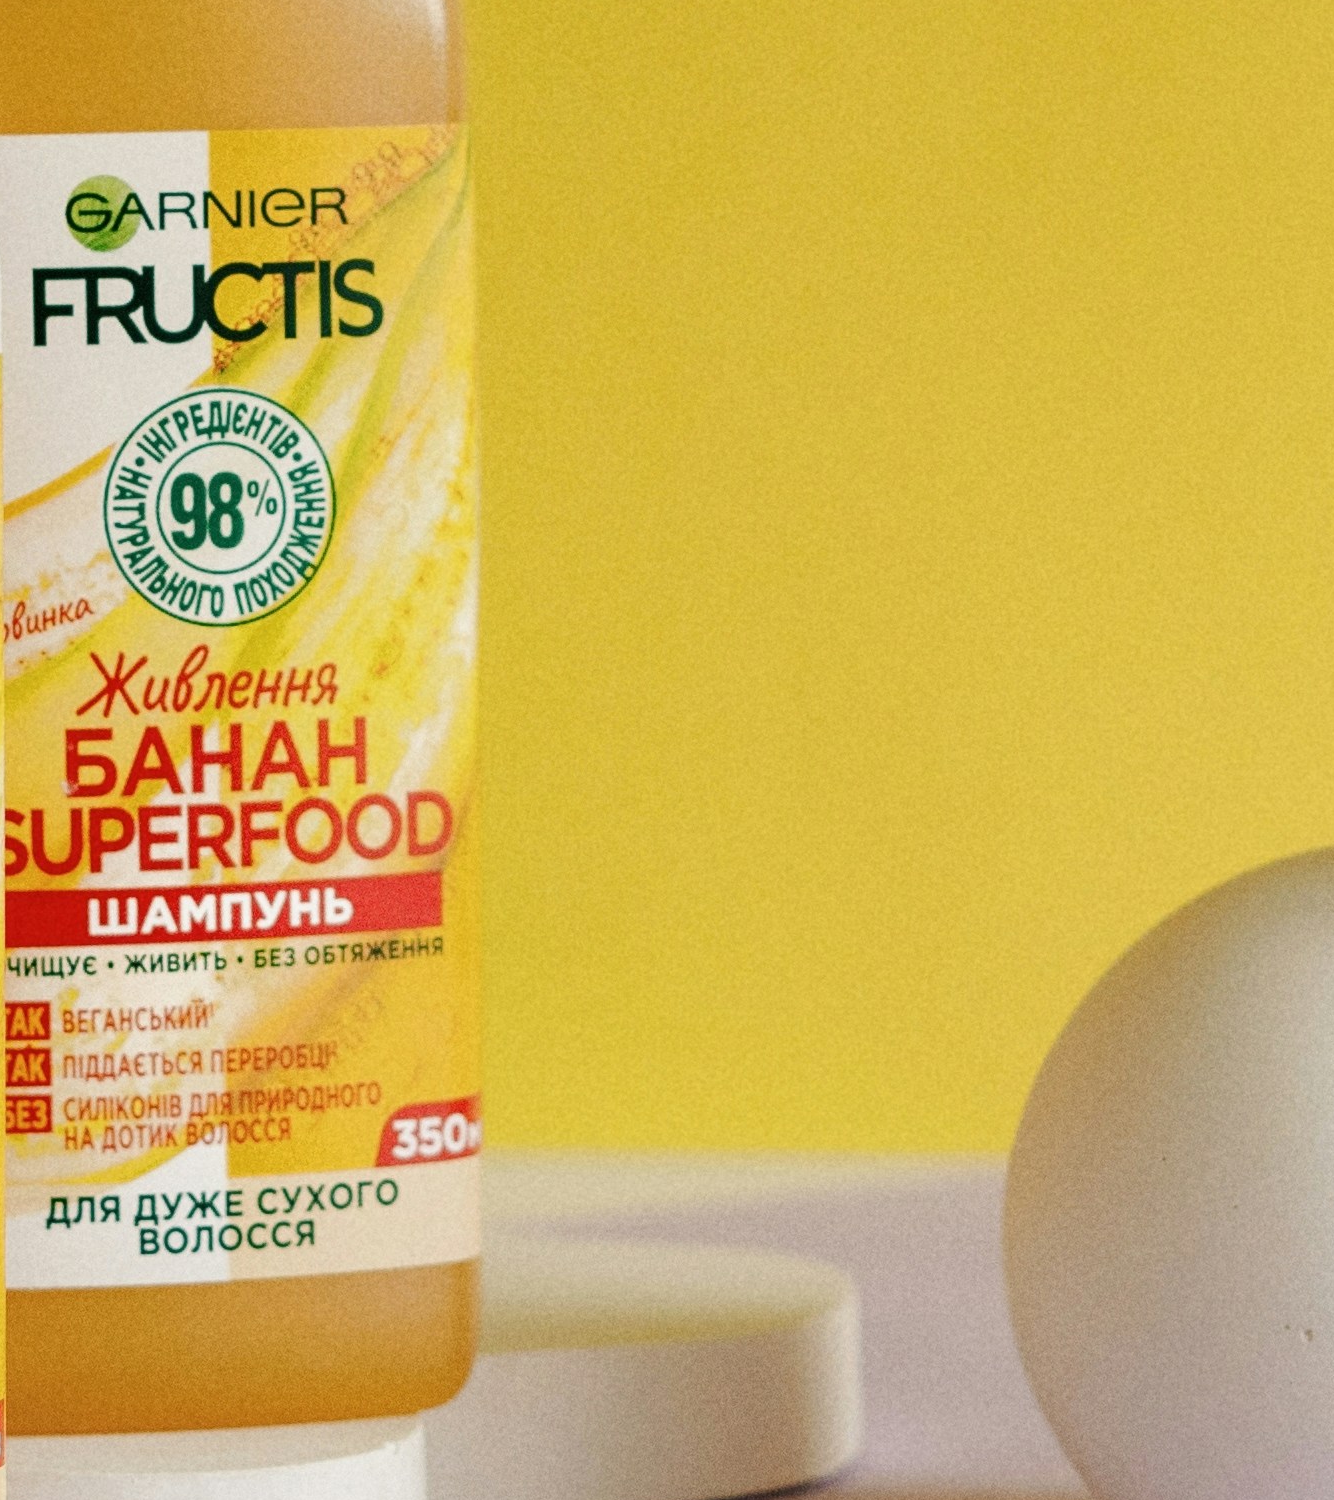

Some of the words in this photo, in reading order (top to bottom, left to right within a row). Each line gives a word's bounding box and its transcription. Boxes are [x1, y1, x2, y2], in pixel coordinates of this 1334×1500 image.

[65, 187, 348, 234] GARNIER
[32, 258, 384, 347] FRUCTIS
[136, 400, 300, 463] ІНГРЕДІЄНТІВ
[170, 471, 278, 551] 98%
[113, 465, 225, 618] НАТУРАЛЬНОГО
[233, 460, 326, 616] ПОХОДЖЕННЯ
[4, 600, 94, 643] винка
[76, 644, 337, 719] Живлення
[65, 716, 367, 798] БАНАН
[5, 790, 454, 877] SUPERFOOD
[87, 888, 354, 937] ШАМПУНЬ
[6, 956, 98, 979] ЧИЩУЄ
[124, 952, 228, 975] ЖИВИТЬ
[253, 946, 297, 968] БЕЗ
[304, 936, 445, 965] ОБТЯЖЕННЯ
[62, 1051, 203, 1083] ПІДДАЄТЬСЯ
[62, 1091, 183, 1122] СИЛІКОНІВ
[188, 1090, 234, 1122] ДЛЯ
[235, 1081, 382, 1115] ПРИРОДНОГО
[63, 1126, 94, 1151] НА
[102, 1124, 178, 1153] ДОТИК
[185, 1117, 292, 1147] ВОЛОССЯ
[46, 1195, 122, 1229] ДЛЯ
[134, 1190, 244, 1227] ДУЖЕ
[256, 1180, 399, 1216] СУХОГО
[138, 1219, 316, 1256] ВОЛОССЯ
